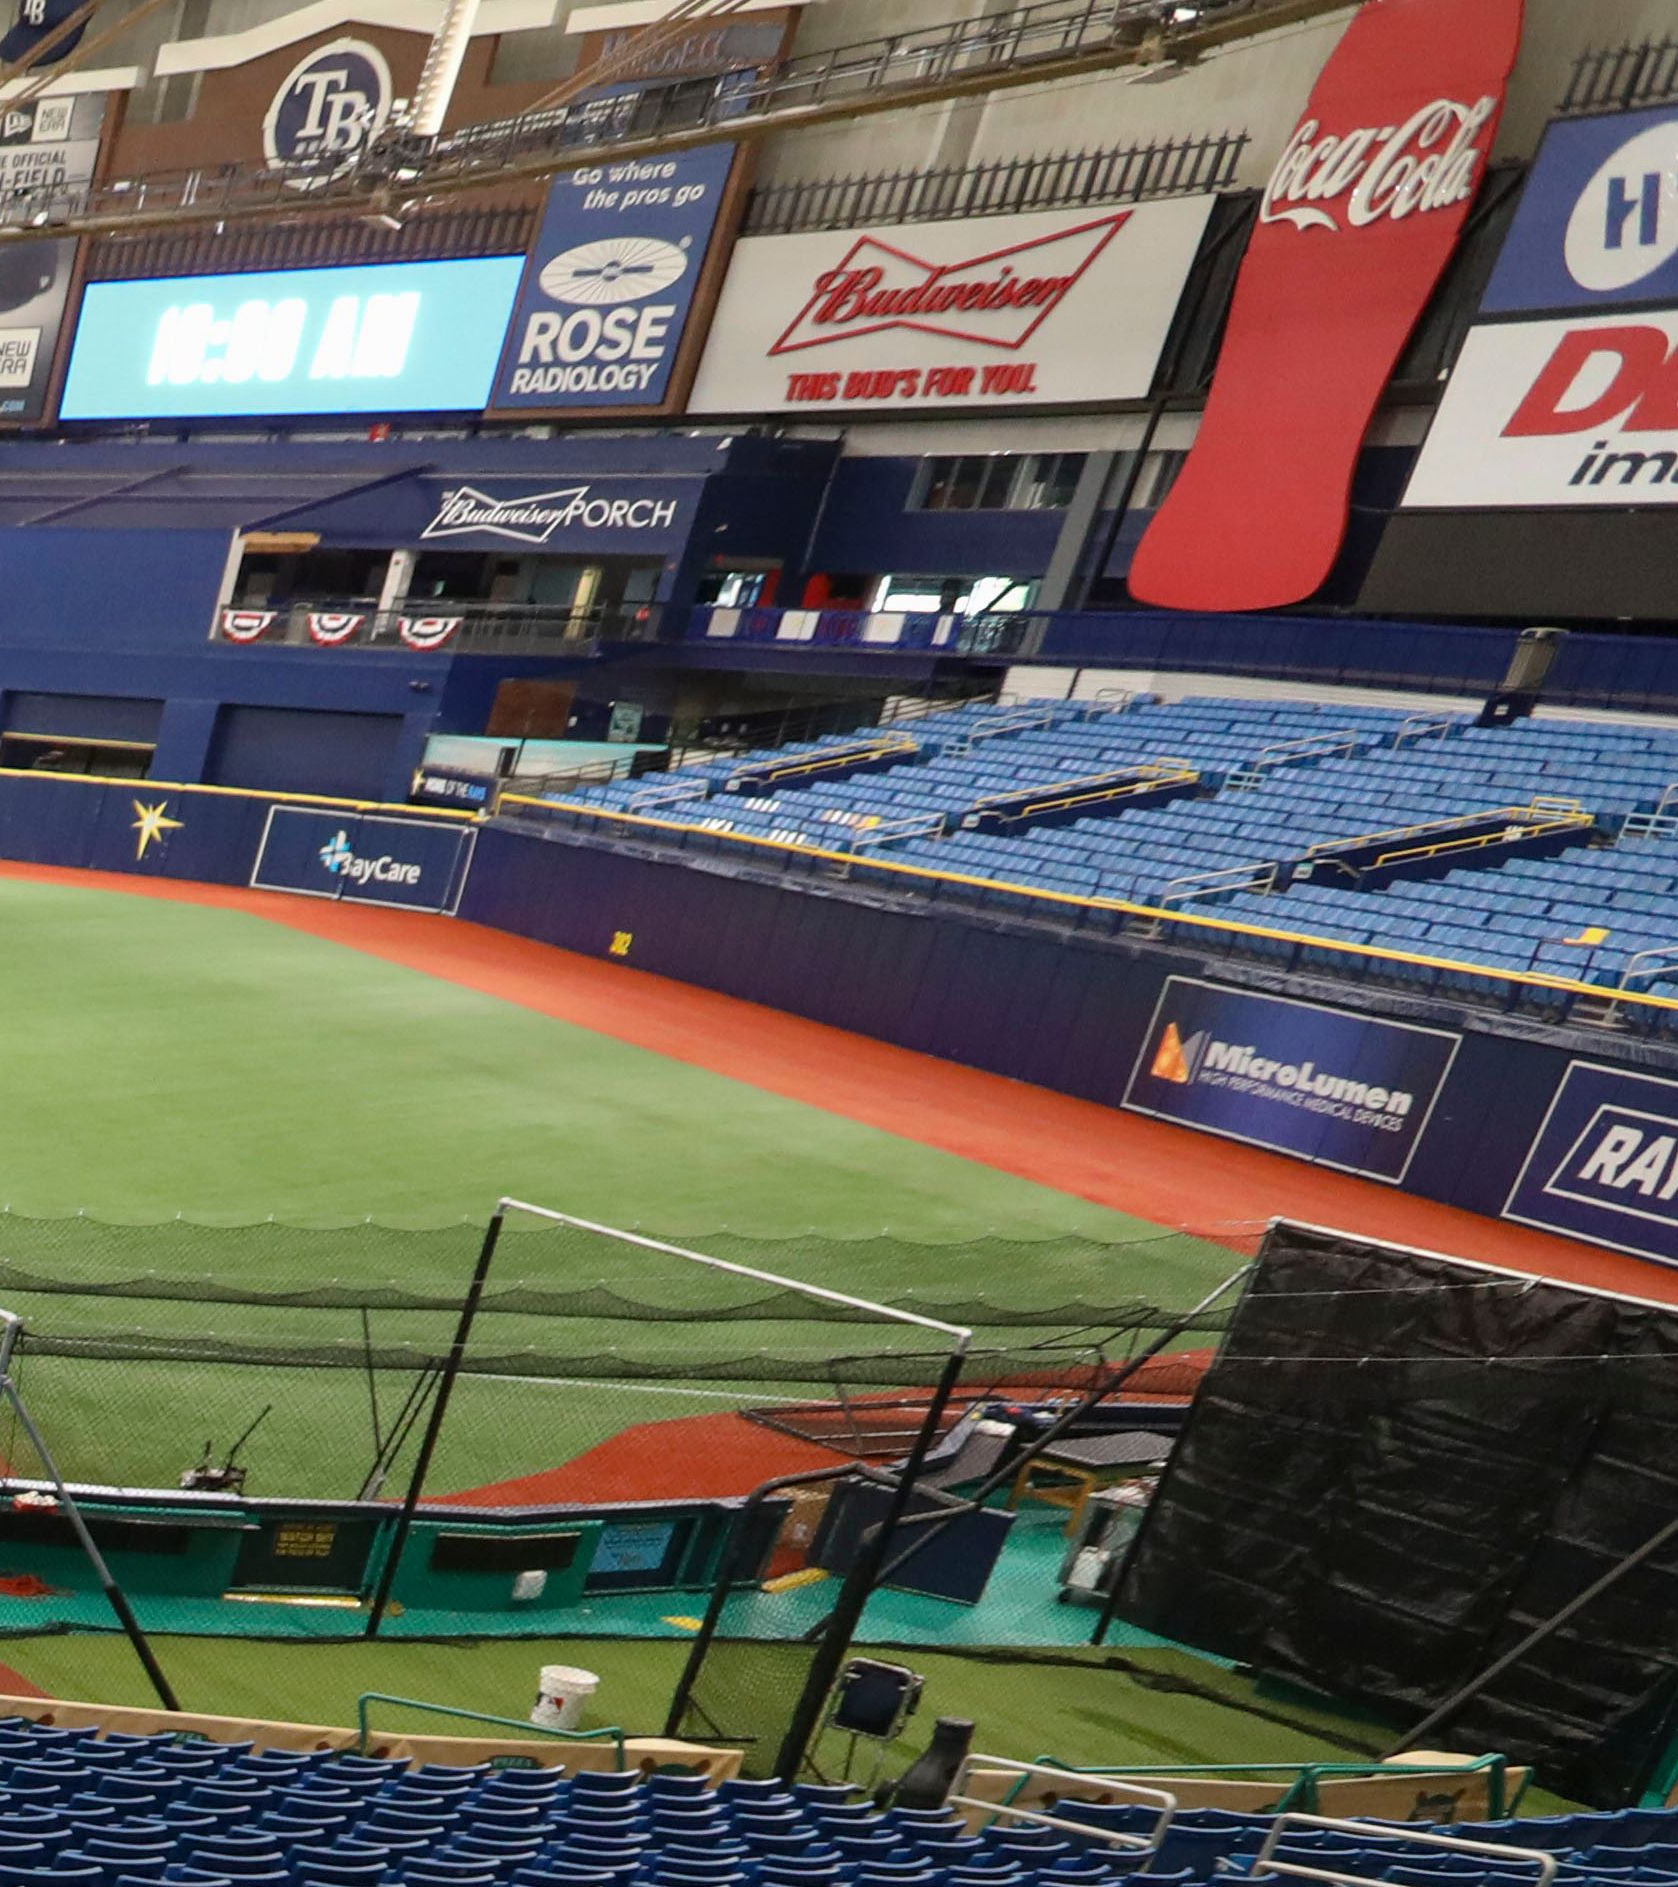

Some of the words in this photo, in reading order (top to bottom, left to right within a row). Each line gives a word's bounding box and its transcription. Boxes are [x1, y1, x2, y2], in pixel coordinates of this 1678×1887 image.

[39, 119, 66, 132] ERA
[41, 106, 69, 119] NEW
[294, 69, 368, 152] TB
[11, 151, 66, 168] OFFICIAL
[572, 167, 602, 187] Go
[609, 160, 677, 183] where
[1260, 95, 1498, 232] Coca-Cola
[582, 188, 615, 211] the
[619, 186, 670, 212] pros
[671, 182, 706, 208] go
[811, 265, 1076, 325] Budweiser
[518, 304, 677, 366] ROSE
[509, 363, 660, 396] RADIOLOGY
[785, 372, 842, 402] THIS
[843, 368, 921, 401] BUD'S
[922, 366, 976, 397] FOR
[978, 362, 1038, 395] YOU.
[1568, 440, 1678, 487] im
[441, 499, 570, 527] Budweiser
[564, 499, 678, 528] PORCH
[1202, 1040, 1414, 1116] MicroLumen
[1225, 1075, 1306, 1109] PERFORMANCE
[1304, 1094, 1354, 1124] MEDICAL
[1352, 1107, 1403, 1133] DEVICES
